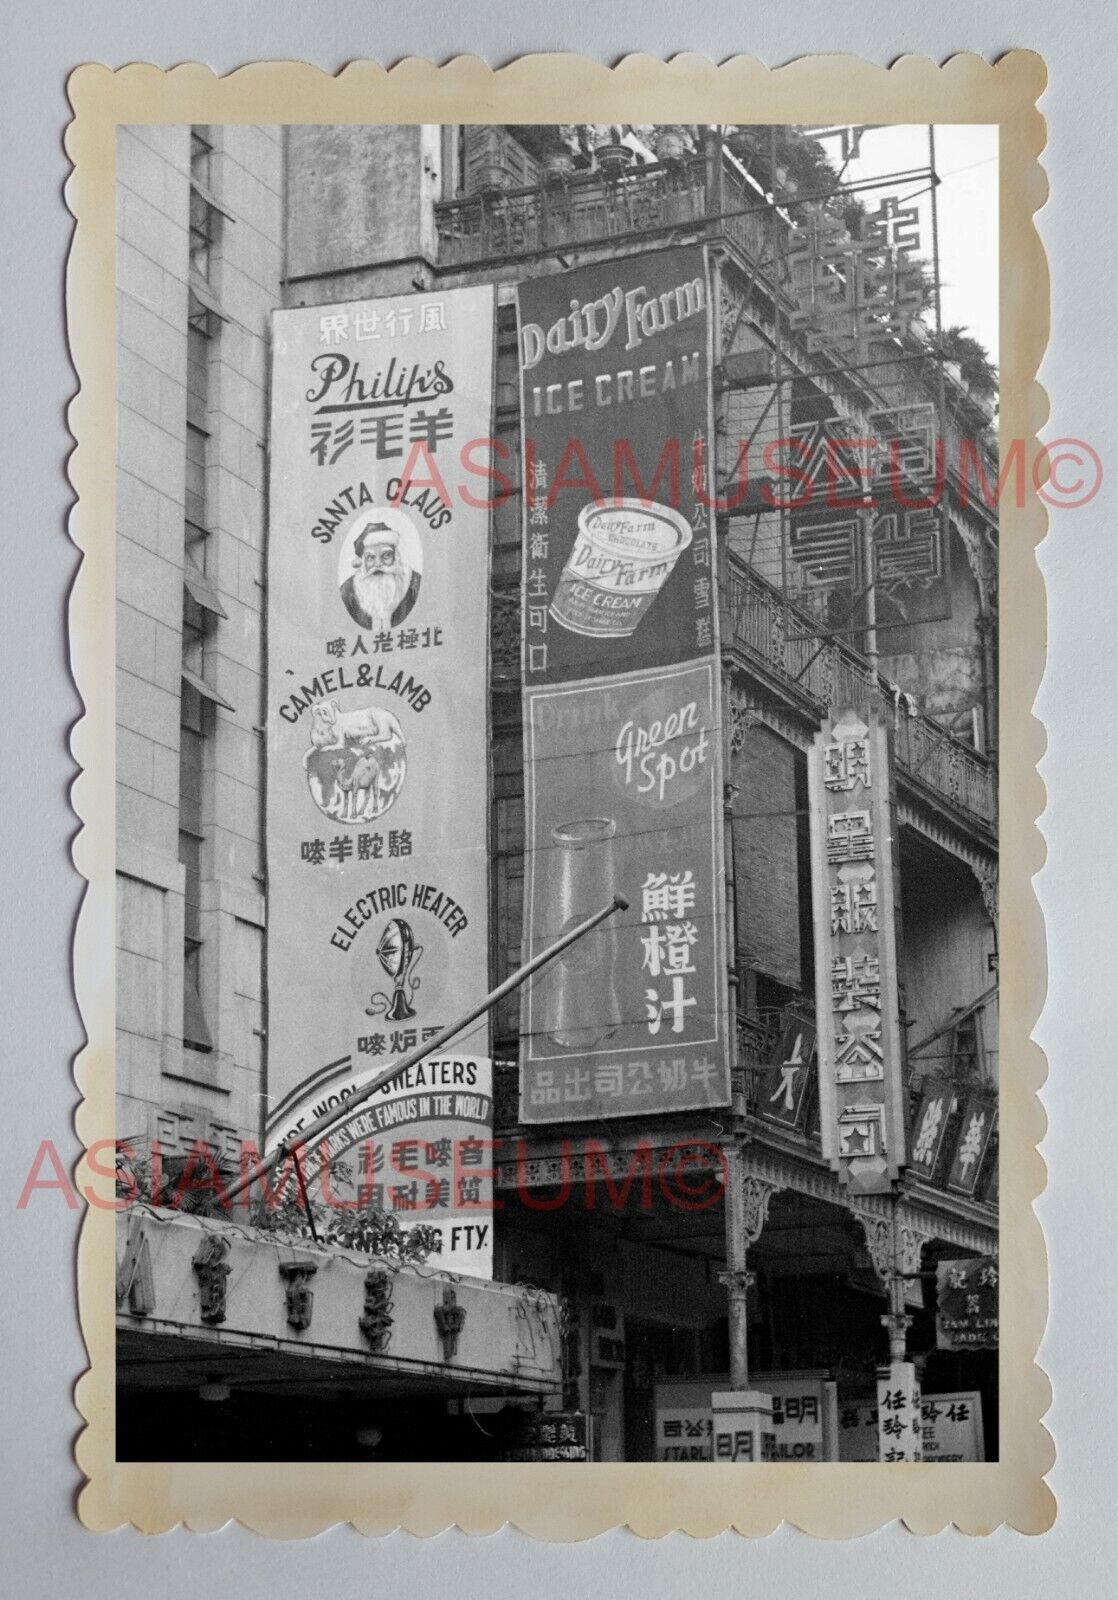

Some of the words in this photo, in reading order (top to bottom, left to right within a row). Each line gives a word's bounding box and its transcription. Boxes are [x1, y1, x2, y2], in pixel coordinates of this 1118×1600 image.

[521, 286, 624, 369] Dairy
[625, 277, 705, 351] Farm
[305, 353, 454, 408] Philip's
[533, 379, 584, 417] ICE
[595, 352, 700, 407] CREAM
[311, 481, 375, 544] SANTA
[386, 477, 453, 530] CLAUS
[570, 583, 593, 602] ICE
[593, 594, 643, 609] CREAM
[576, 543, 621, 574] Dairy
[615, 561, 669, 586] Farm
[615, 701, 700, 785] Green
[637, 727, 709, 801] Spot
[330, 882, 407, 952] ELECTRIC
[411, 883, 469, 938] HEATER
[640, 870, 698, 1035] 鮮橙汁
[345, 1111, 378, 1140] WERE
[375, 1099, 418, 1127] FAMOUS
[419, 1096, 431, 1117] IN
[432, 1094, 452, 1116] THE
[455, 1095, 489, 1120] WORLD
[451, 1225, 489, 1251] FTY.
